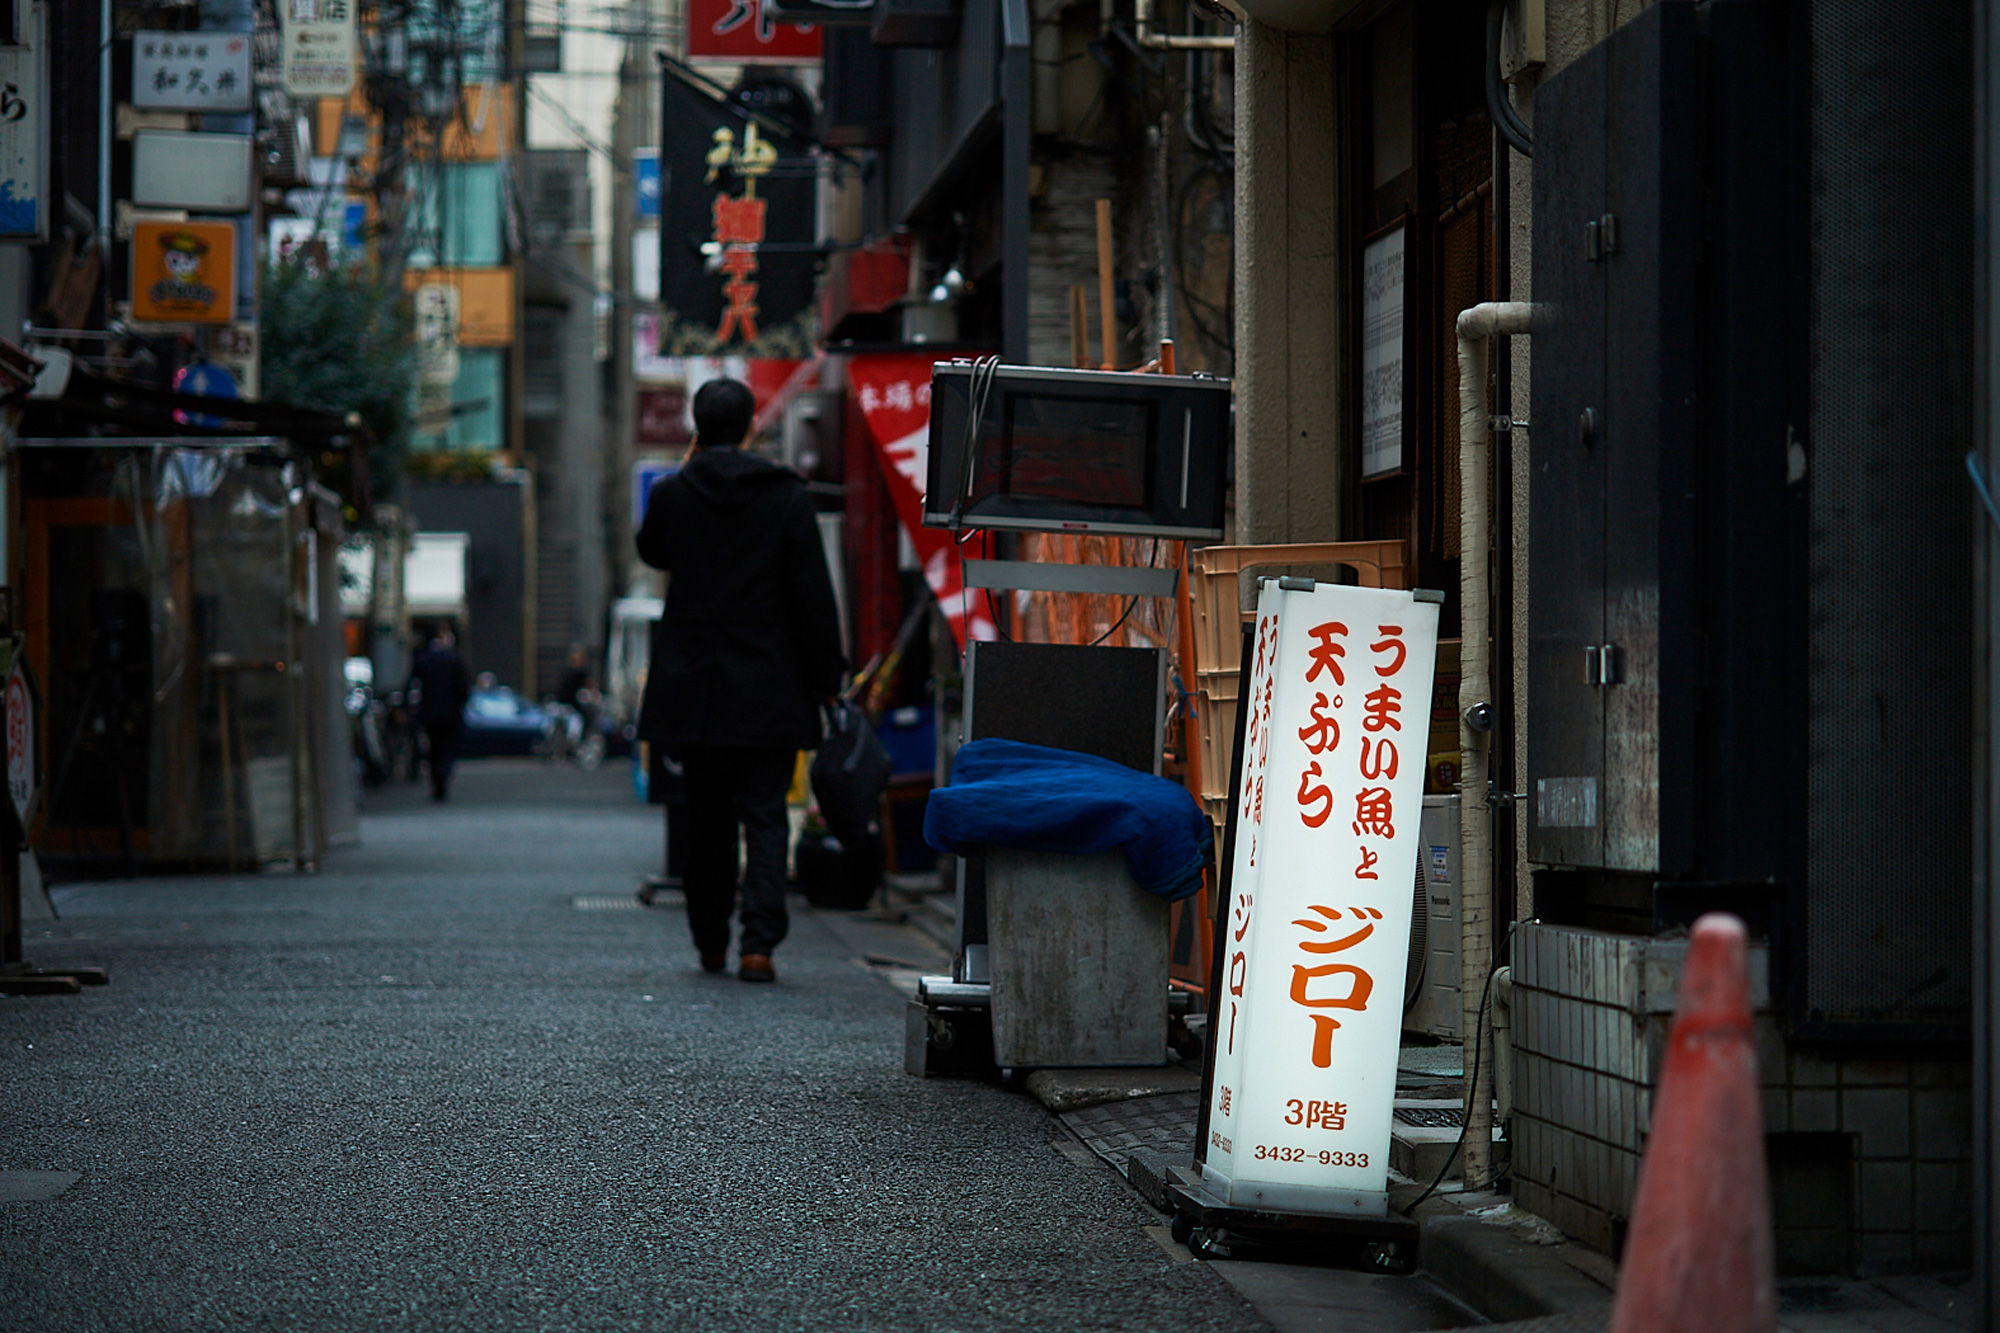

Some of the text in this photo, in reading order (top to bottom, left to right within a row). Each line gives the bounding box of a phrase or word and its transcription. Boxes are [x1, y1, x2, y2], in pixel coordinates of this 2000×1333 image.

[1297, 621, 1349, 829] 天ぷら
[1352, 624, 1407, 881] うまい魚と
[1229, 894, 1253, 1056] ジロー
[1290, 905, 1384, 1069] ジロー
[1254, 1145, 1370, 1168] 3432-9333
[1284, 1098, 1347, 1131] 3階
